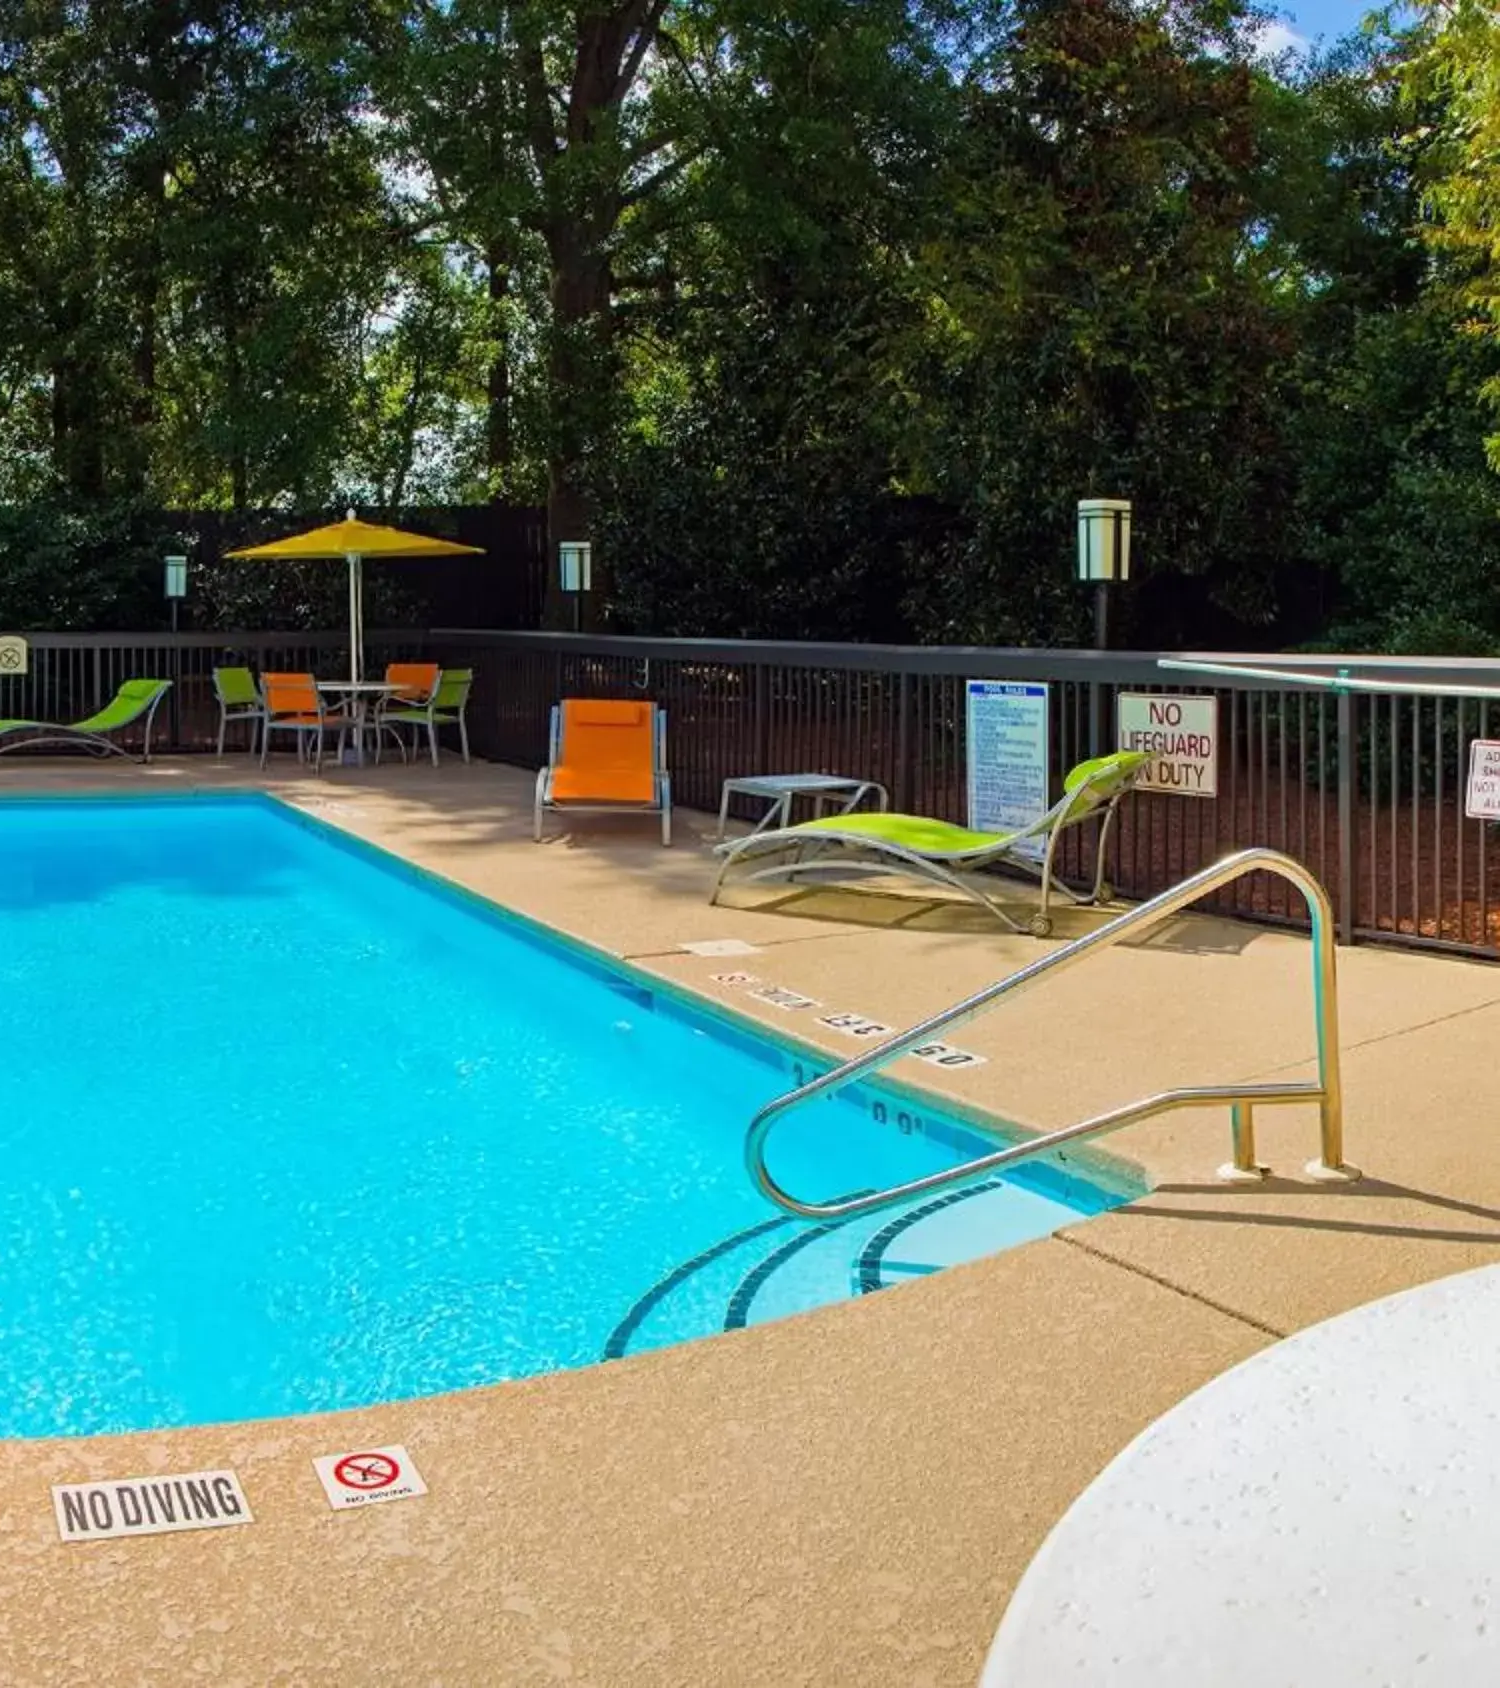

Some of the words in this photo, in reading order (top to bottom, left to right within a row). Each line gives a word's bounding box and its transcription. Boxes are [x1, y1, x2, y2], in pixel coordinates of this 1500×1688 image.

[1149, 702, 1182, 726] NO
[1122, 731, 1211, 758] LIFEGUARD
[1160, 761, 1205, 788] DUTY
[61, 1489, 113, 1532] NO
[116, 1477, 241, 1526] DIVING
